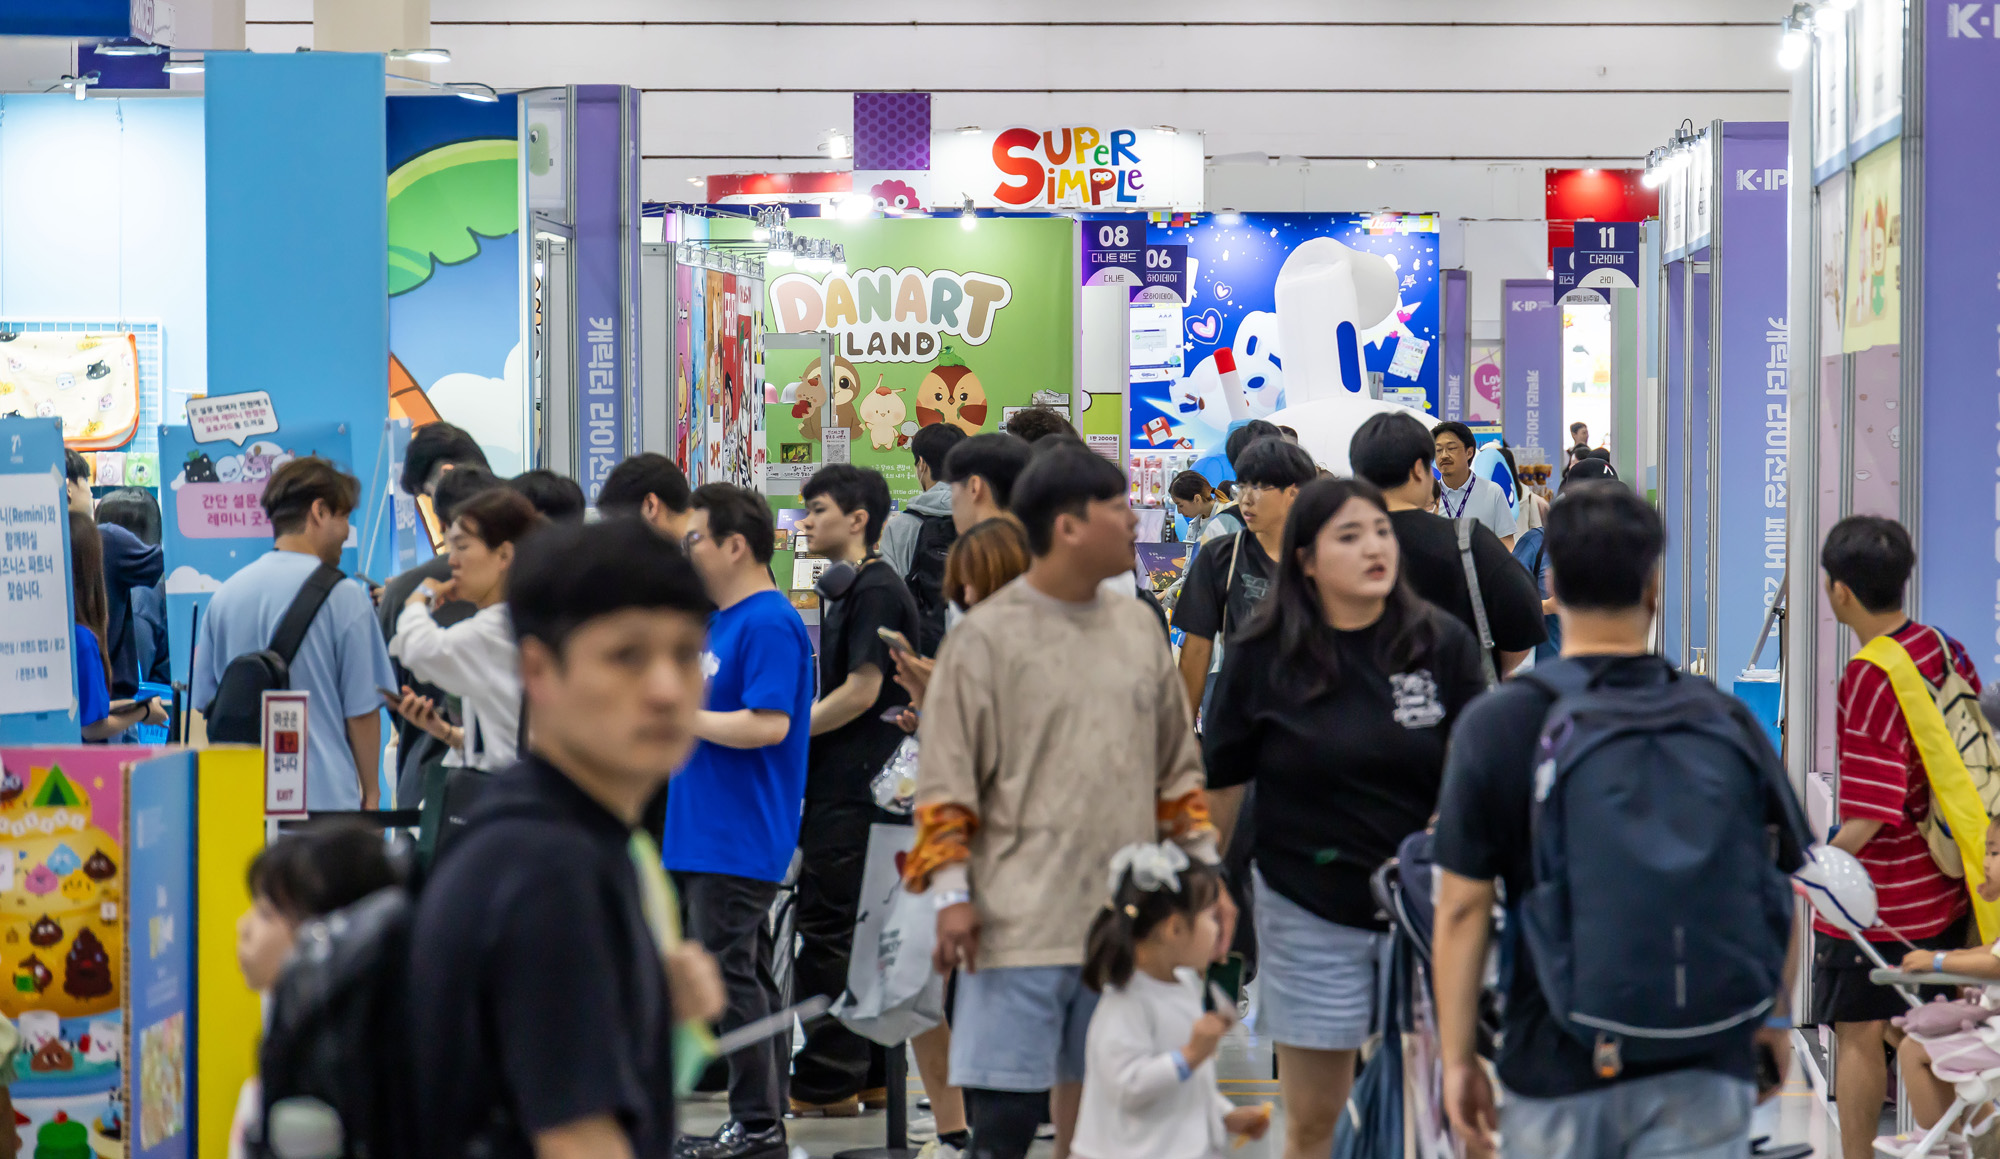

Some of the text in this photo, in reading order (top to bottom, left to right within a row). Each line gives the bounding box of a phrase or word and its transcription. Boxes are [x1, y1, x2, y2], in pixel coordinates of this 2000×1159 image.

[1099, 226, 1129, 247] 08
[1599, 227, 1615, 248] 11
[1091, 253, 1137, 263] 다나트 랜드
[1146, 249, 1172, 268] 06
[1589, 254, 1624, 264] 다라미네
[1103, 275, 1125, 283] 다나트
[1600, 276, 1614, 284] 라미
[776, 273, 1005, 338] DANART
[1142, 292, 1174, 300] 오하이데이
[847, 332, 934, 356] LAND
[588, 317, 614, 394] 캐릭터
[1447, 375, 1460, 410] 캐릭터
[1526, 370, 1539, 448] 캐릭터 라이선
[1765, 403, 1787, 508] 라이선싱
[202, 494, 227, 510] 간단
[207, 511, 246, 527] 레미니
[6, 530, 37, 552] 함께하실
[1764, 516, 1786, 569] 페어
[28, 554, 54, 574] 파트너
[7, 580, 42, 601] 찾습니다.
